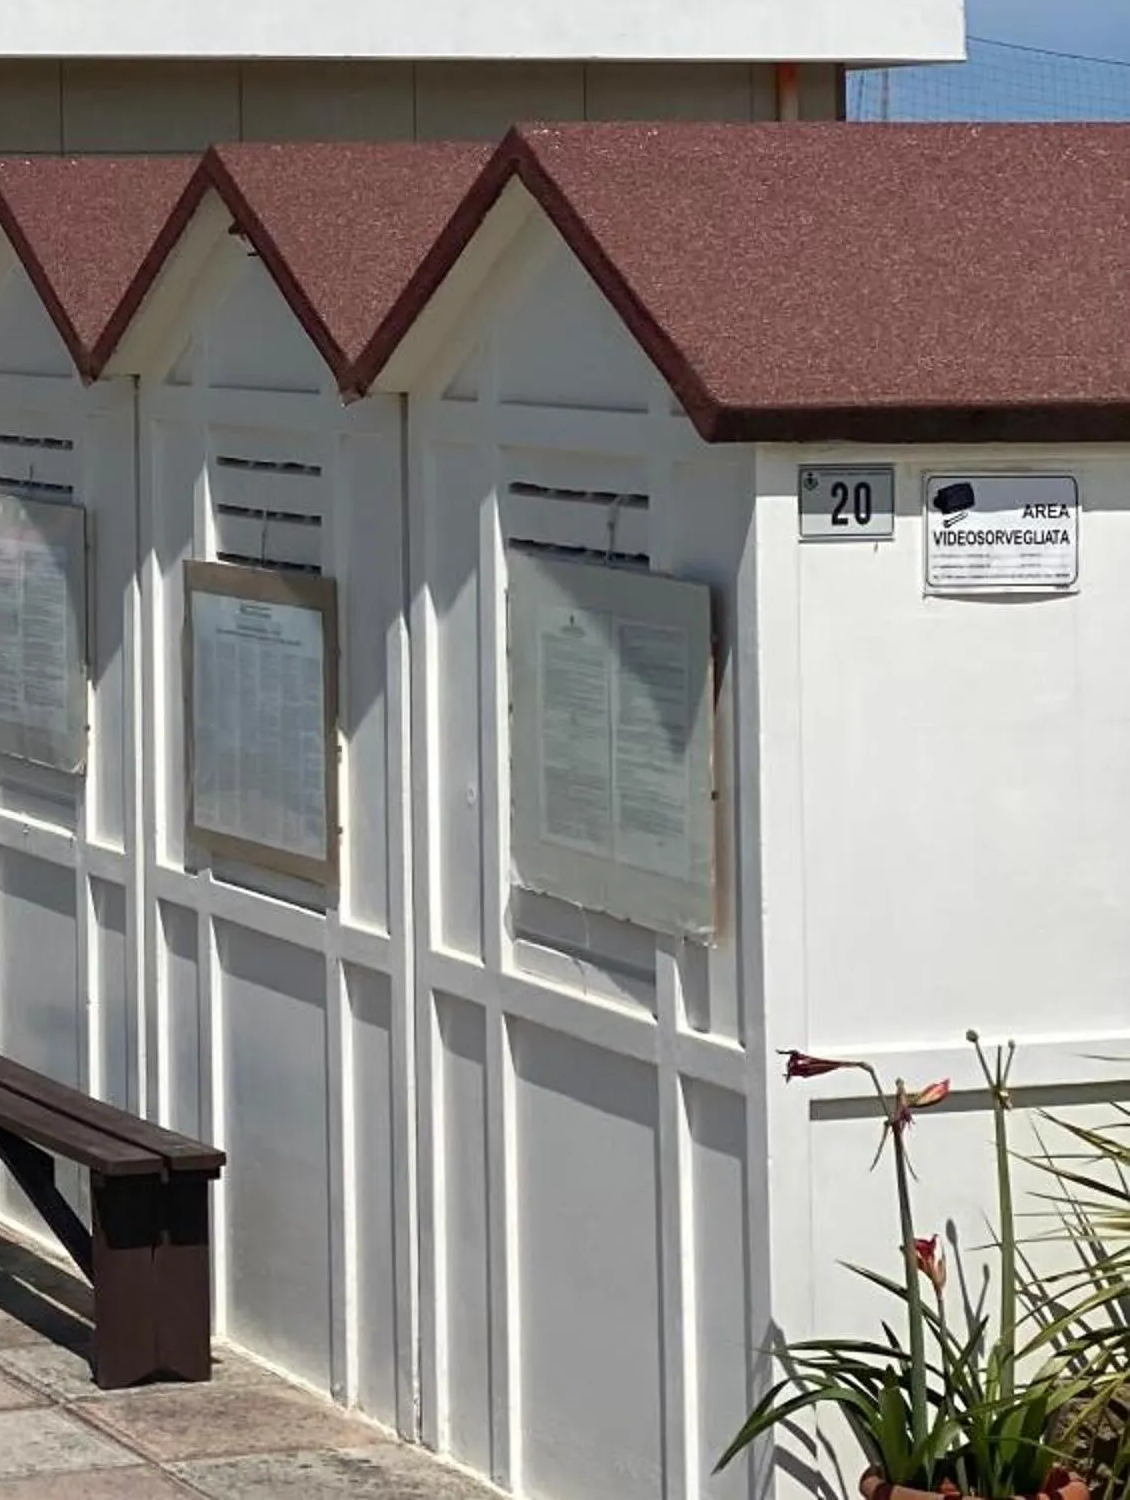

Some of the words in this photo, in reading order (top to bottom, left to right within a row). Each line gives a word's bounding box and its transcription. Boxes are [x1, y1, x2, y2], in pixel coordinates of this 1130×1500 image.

[831, 481, 872, 526] 20
[1022, 503, 1070, 519] AREA
[933, 529, 1070, 546] VIDEOSORVEGLIATA
